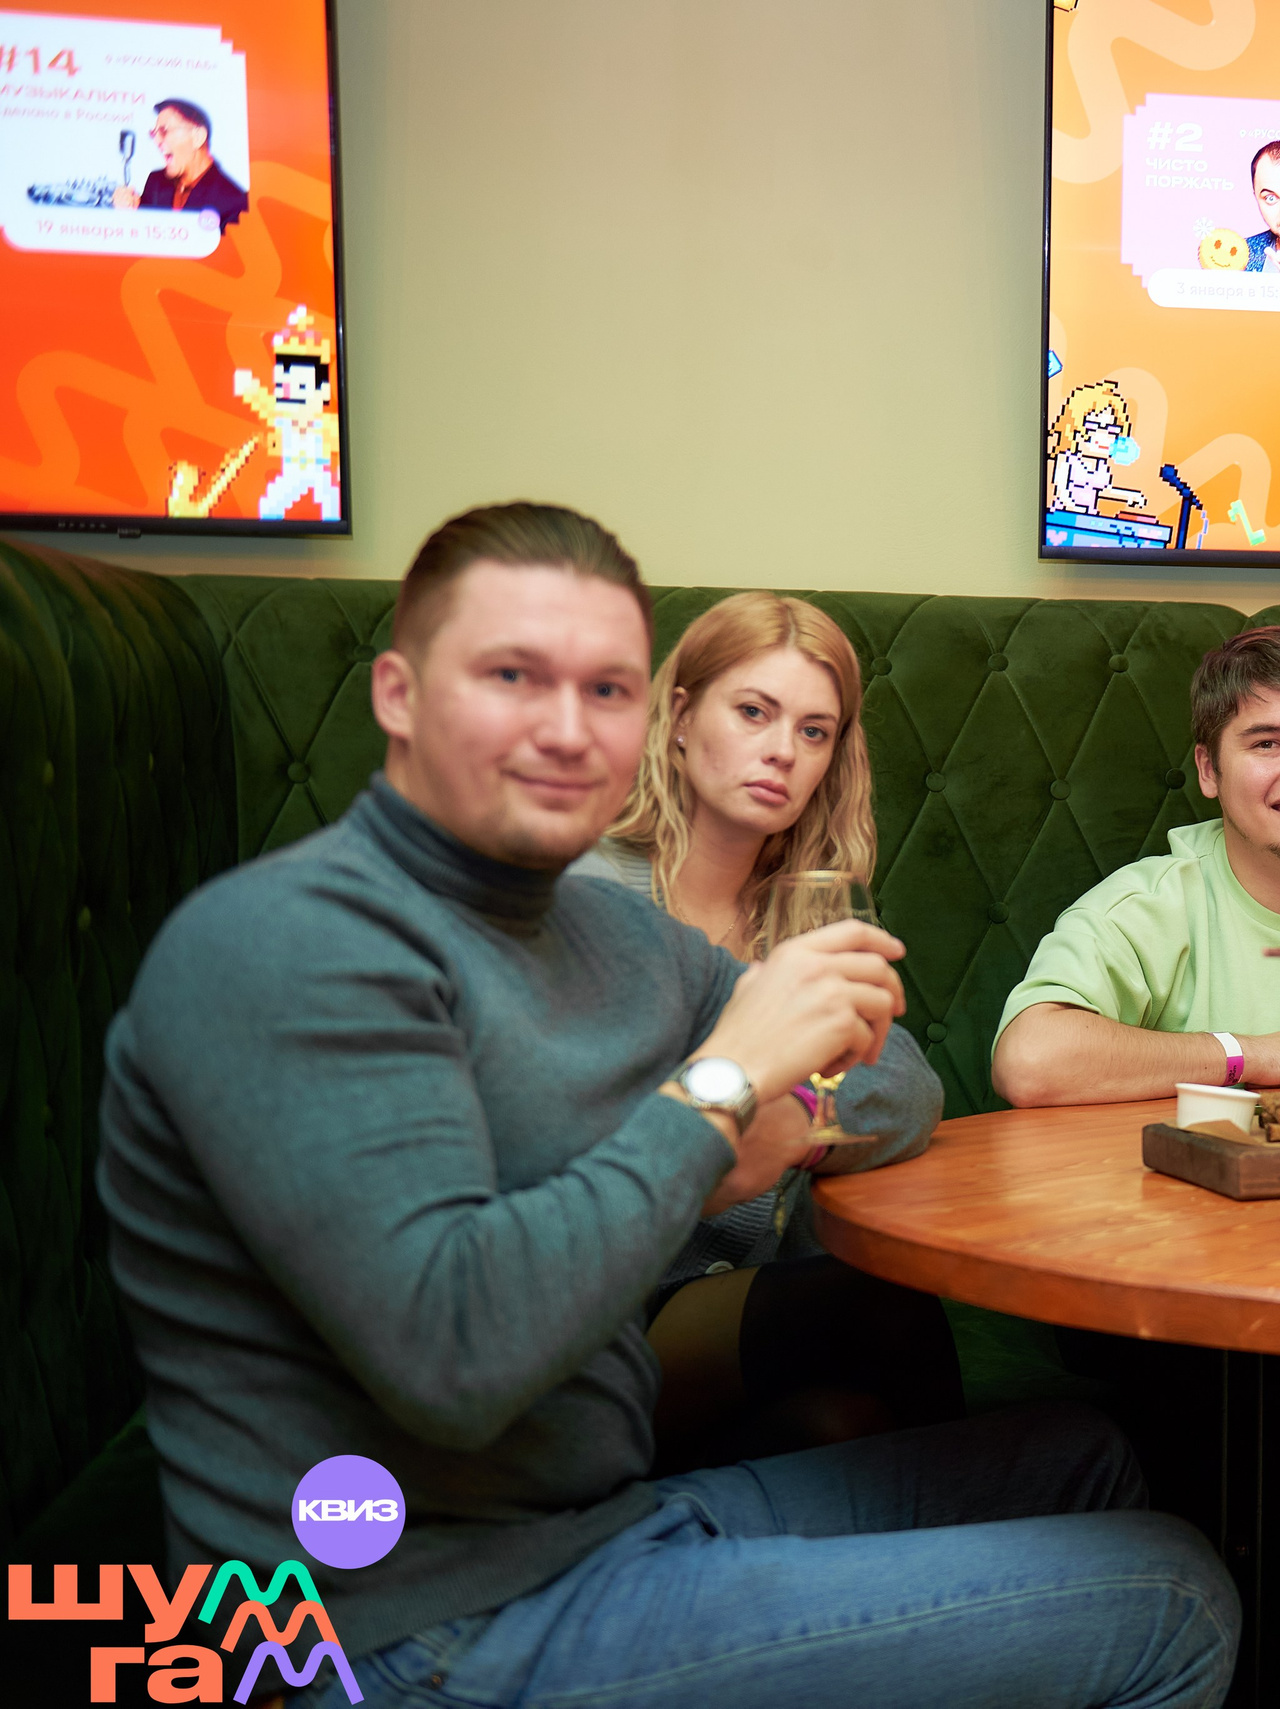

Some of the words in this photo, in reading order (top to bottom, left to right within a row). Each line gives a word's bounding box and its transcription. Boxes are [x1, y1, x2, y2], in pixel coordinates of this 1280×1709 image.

[1147, 121, 1204, 152] #2
[1145, 158, 1208, 173] ЧИСТО
[1145, 175, 1235, 191] ПОРЖАТЬ
[59, 223, 124, 240] января
[130, 227, 139, 237] в
[145, 226, 189, 241] 15:30
[1176, 282, 1185, 294] 3
[1190, 285, 1244, 300] января
